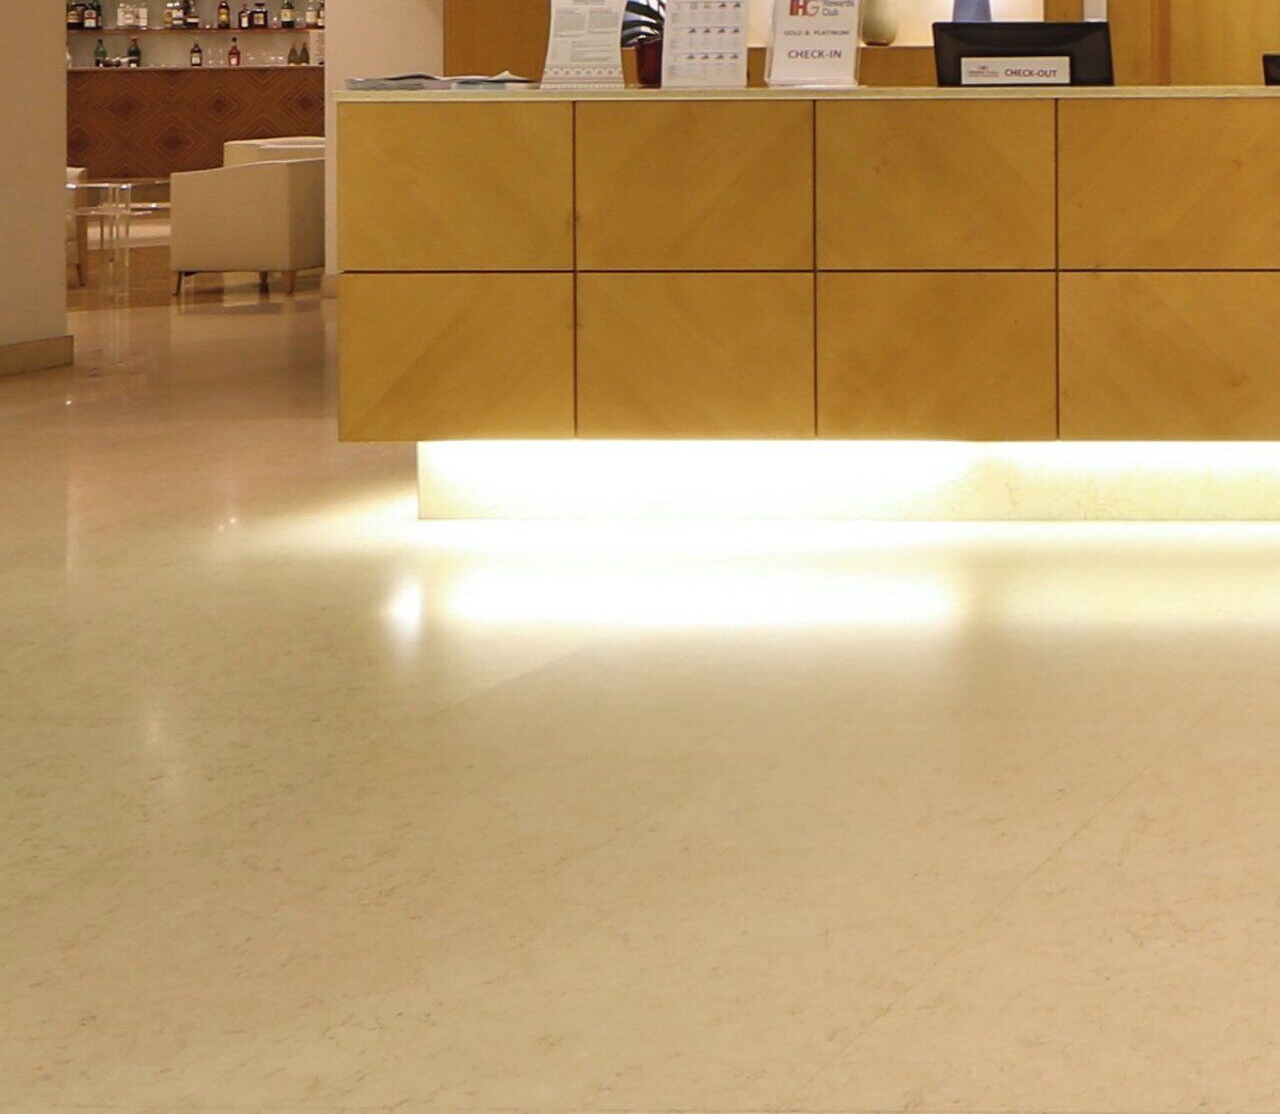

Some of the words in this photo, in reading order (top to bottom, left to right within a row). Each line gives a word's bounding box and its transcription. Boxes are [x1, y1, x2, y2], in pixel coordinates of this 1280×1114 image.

[821, 7, 839, 17] Club
[787, 48, 843, 60] CHECK-IN
[1004, 68, 1057, 78] CHECK-OUT
